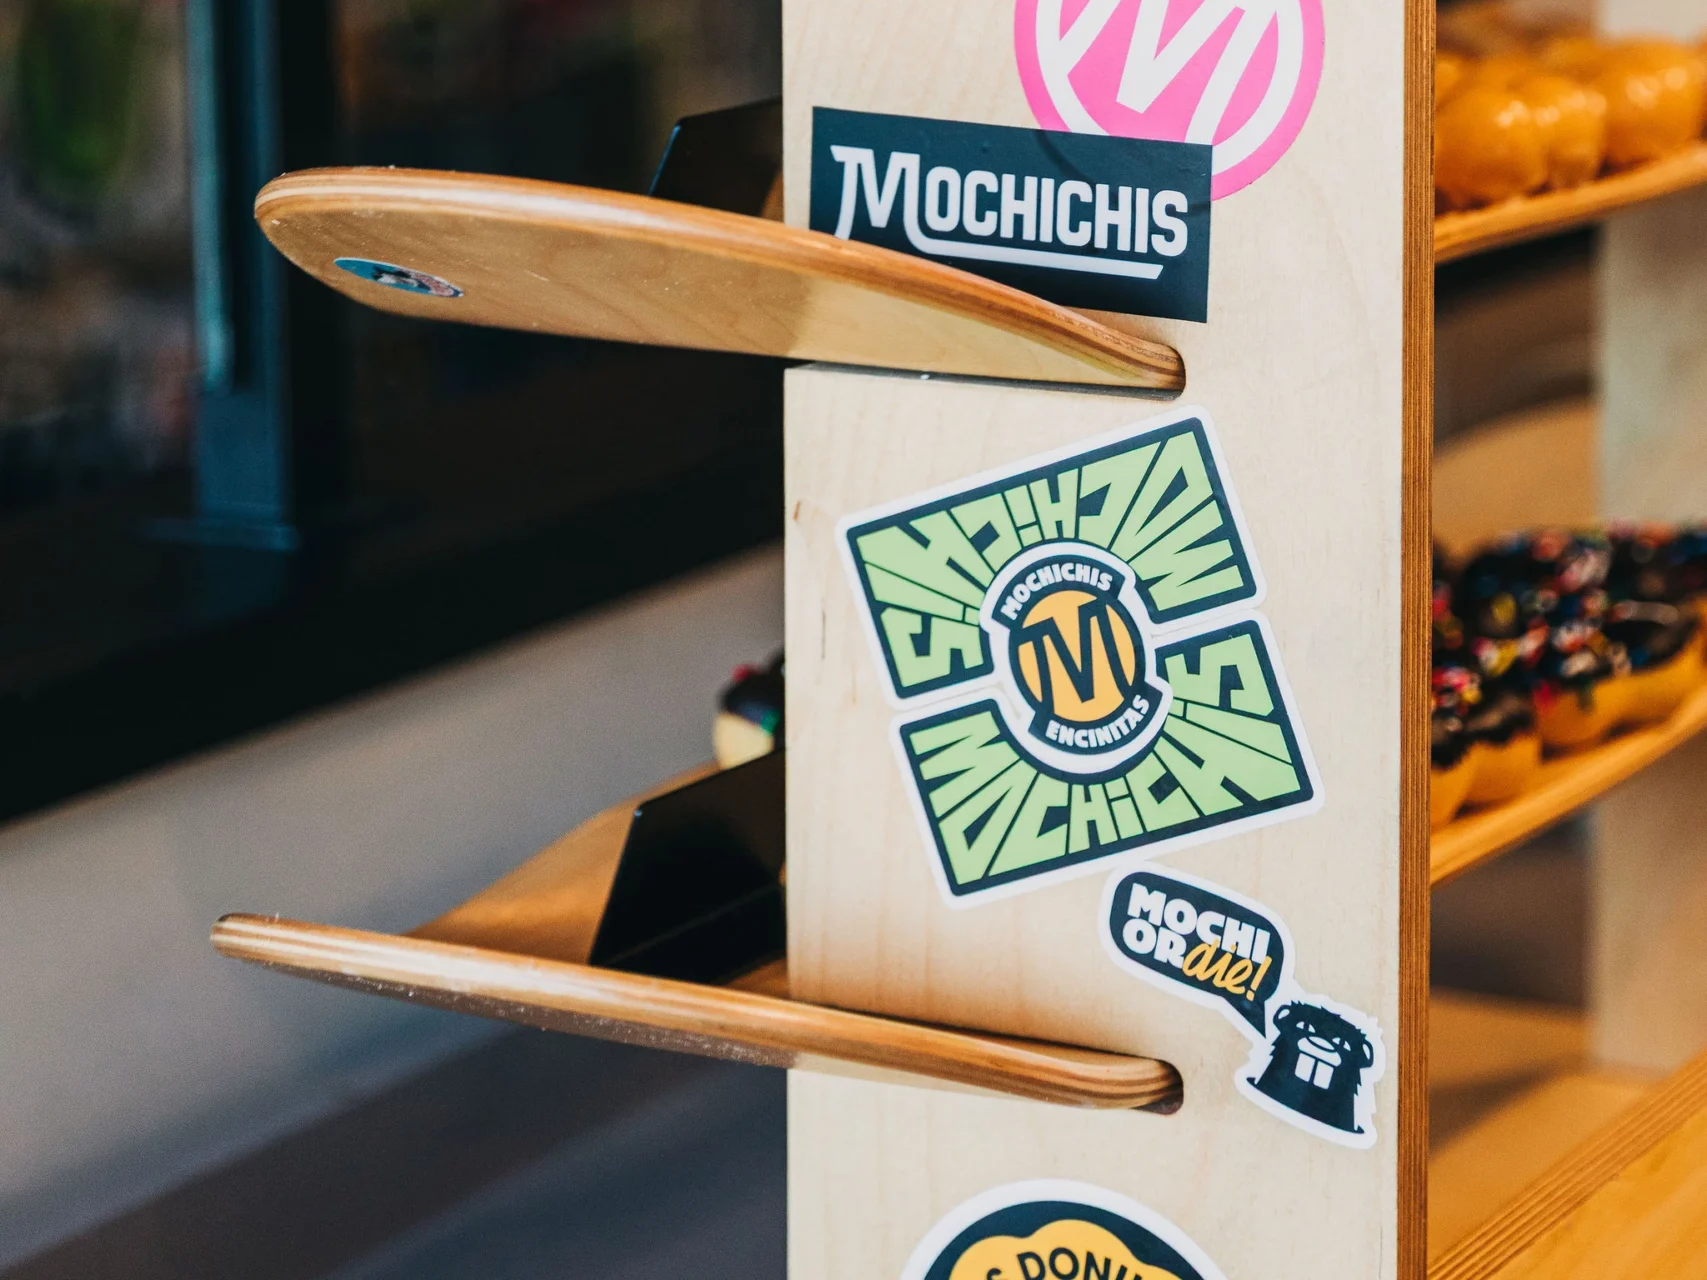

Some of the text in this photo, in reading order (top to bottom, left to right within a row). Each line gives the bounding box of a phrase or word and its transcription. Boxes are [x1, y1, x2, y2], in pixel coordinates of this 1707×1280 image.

[830, 144, 1190, 279] MOCHICHIS
[1000, 562, 1114, 621] MOCHICHIS
[1045, 694, 1150, 749] ENCINITAS
[1122, 918, 1273, 1002] OR die!
[1127, 882, 1271, 964] MOCHI
